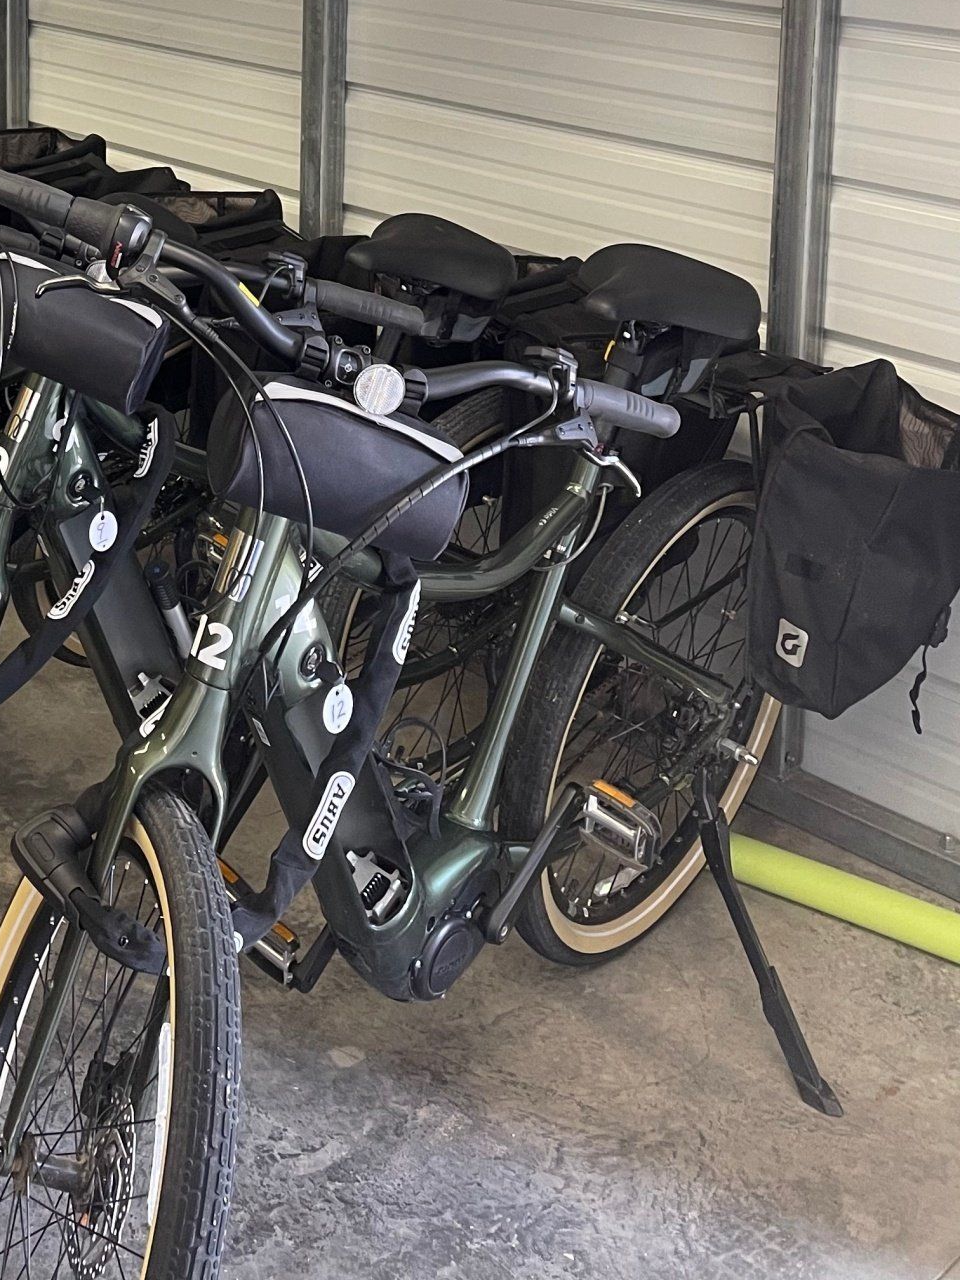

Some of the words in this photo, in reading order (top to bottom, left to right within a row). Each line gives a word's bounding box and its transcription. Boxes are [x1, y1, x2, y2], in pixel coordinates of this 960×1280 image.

[190, 614, 234, 670] 12
[331, 700, 346, 723] 12
[312, 782, 346, 848] ABUS
